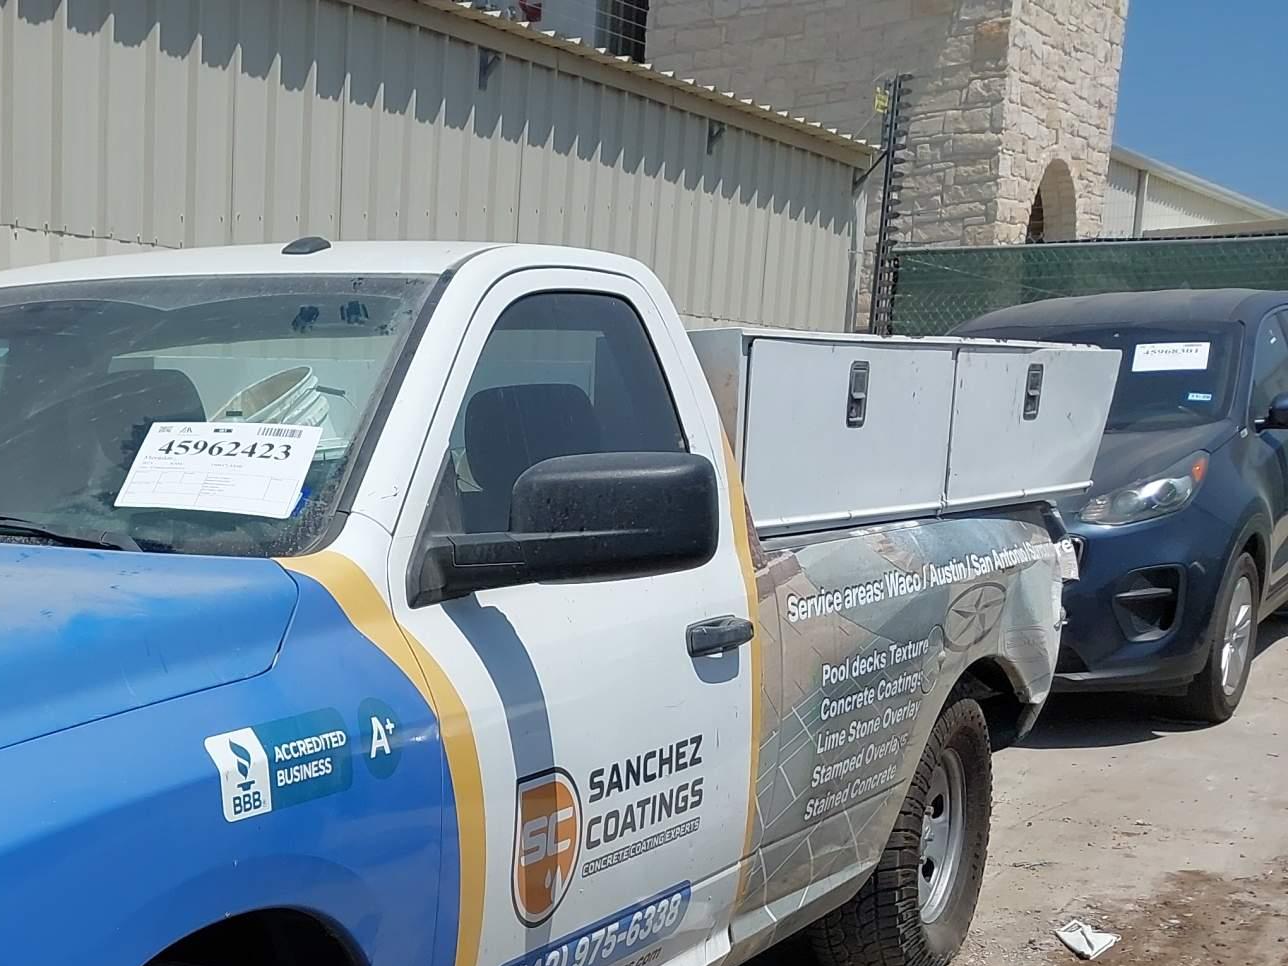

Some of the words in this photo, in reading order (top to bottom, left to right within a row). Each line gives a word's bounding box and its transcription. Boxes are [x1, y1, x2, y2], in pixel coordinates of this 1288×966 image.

[158, 440, 292, 461] 45962423
[787, 588, 843, 622] Service
[844, 580, 885, 609] areas:
[884, 570, 921, 599] Waco
[929, 559, 967, 587] Austin
[971, 553, 994, 576] San
[822, 656, 850, 688] Pool
[852, 650, 887, 678] decks
[889, 638, 929, 664] Texture
[820, 685, 875, 721] Concrete
[877, 669, 925, 698] Coatings
[274, 730, 347, 762] ACCREDITED
[370, 716, 395, 758] A+
[817, 729, 845, 754] Lime
[848, 717, 880, 742] Stone
[882, 699, 921, 727] Overlay
[277, 758, 332, 787] BUSINESS
[588, 734, 703, 803] SANCHEZ
[812, 752, 863, 788] Stamped
[865, 732, 910, 765] Overlays
[232, 791, 262, 815] BBB
[586, 777, 704, 850] COATINGS
[804, 789, 849, 821] Stained
[850, 764, 897, 799] Concrete
[521, 806, 574, 867] SC
[582, 848, 630, 877] CONCRETE
[630, 833, 666, 857] COATING
[665, 818, 701, 841] EXPERTS
